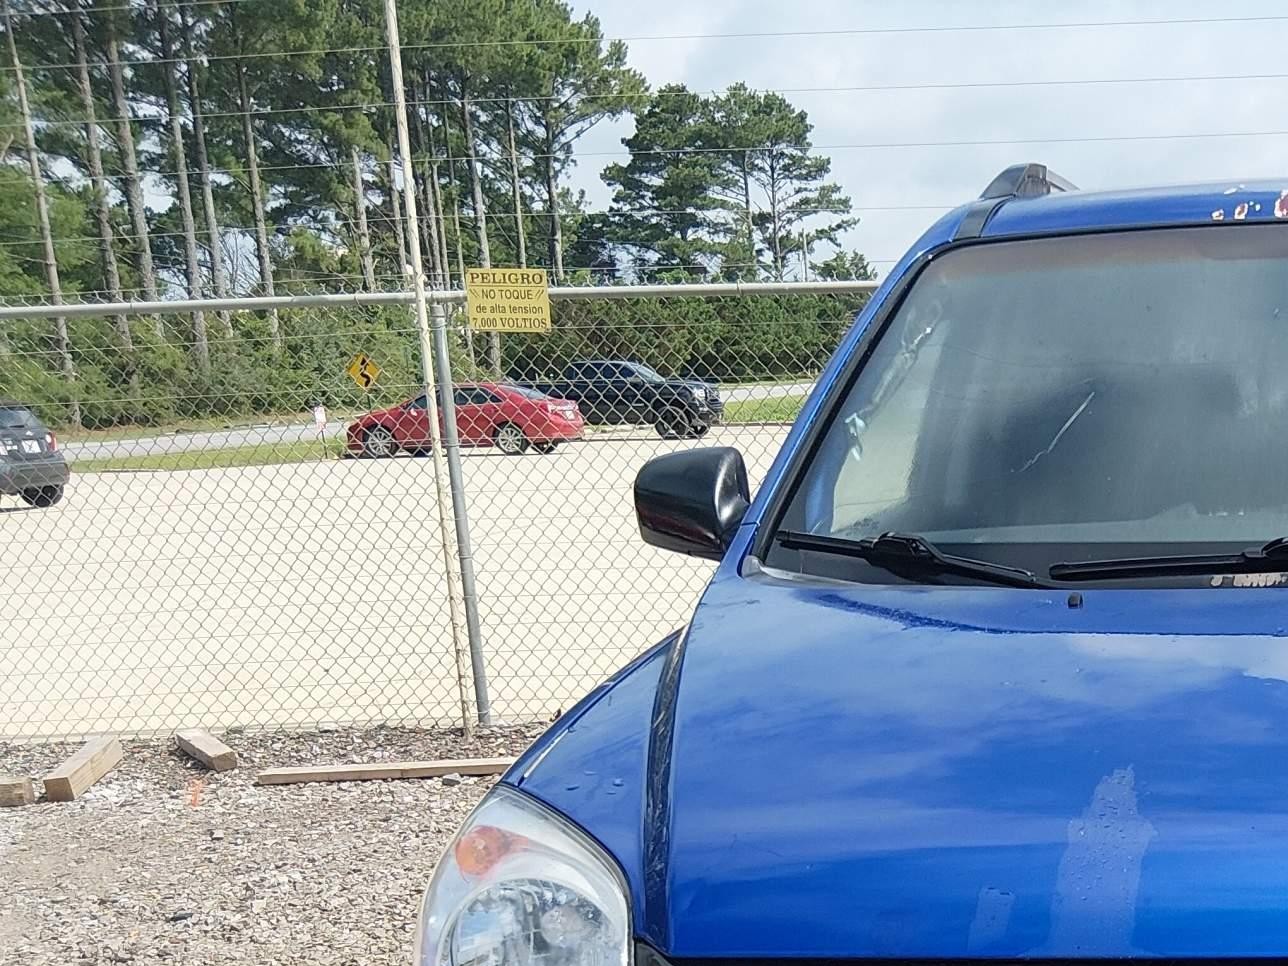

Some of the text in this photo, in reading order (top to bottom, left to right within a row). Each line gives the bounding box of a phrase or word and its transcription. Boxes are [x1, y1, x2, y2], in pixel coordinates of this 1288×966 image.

[470, 272, 543, 285] PELIGRO
[482, 289, 533, 300] NO TOQUE
[476, 303, 543, 315] de alta tension
[472, 317, 547, 329] 7,000 VOLTIOS
